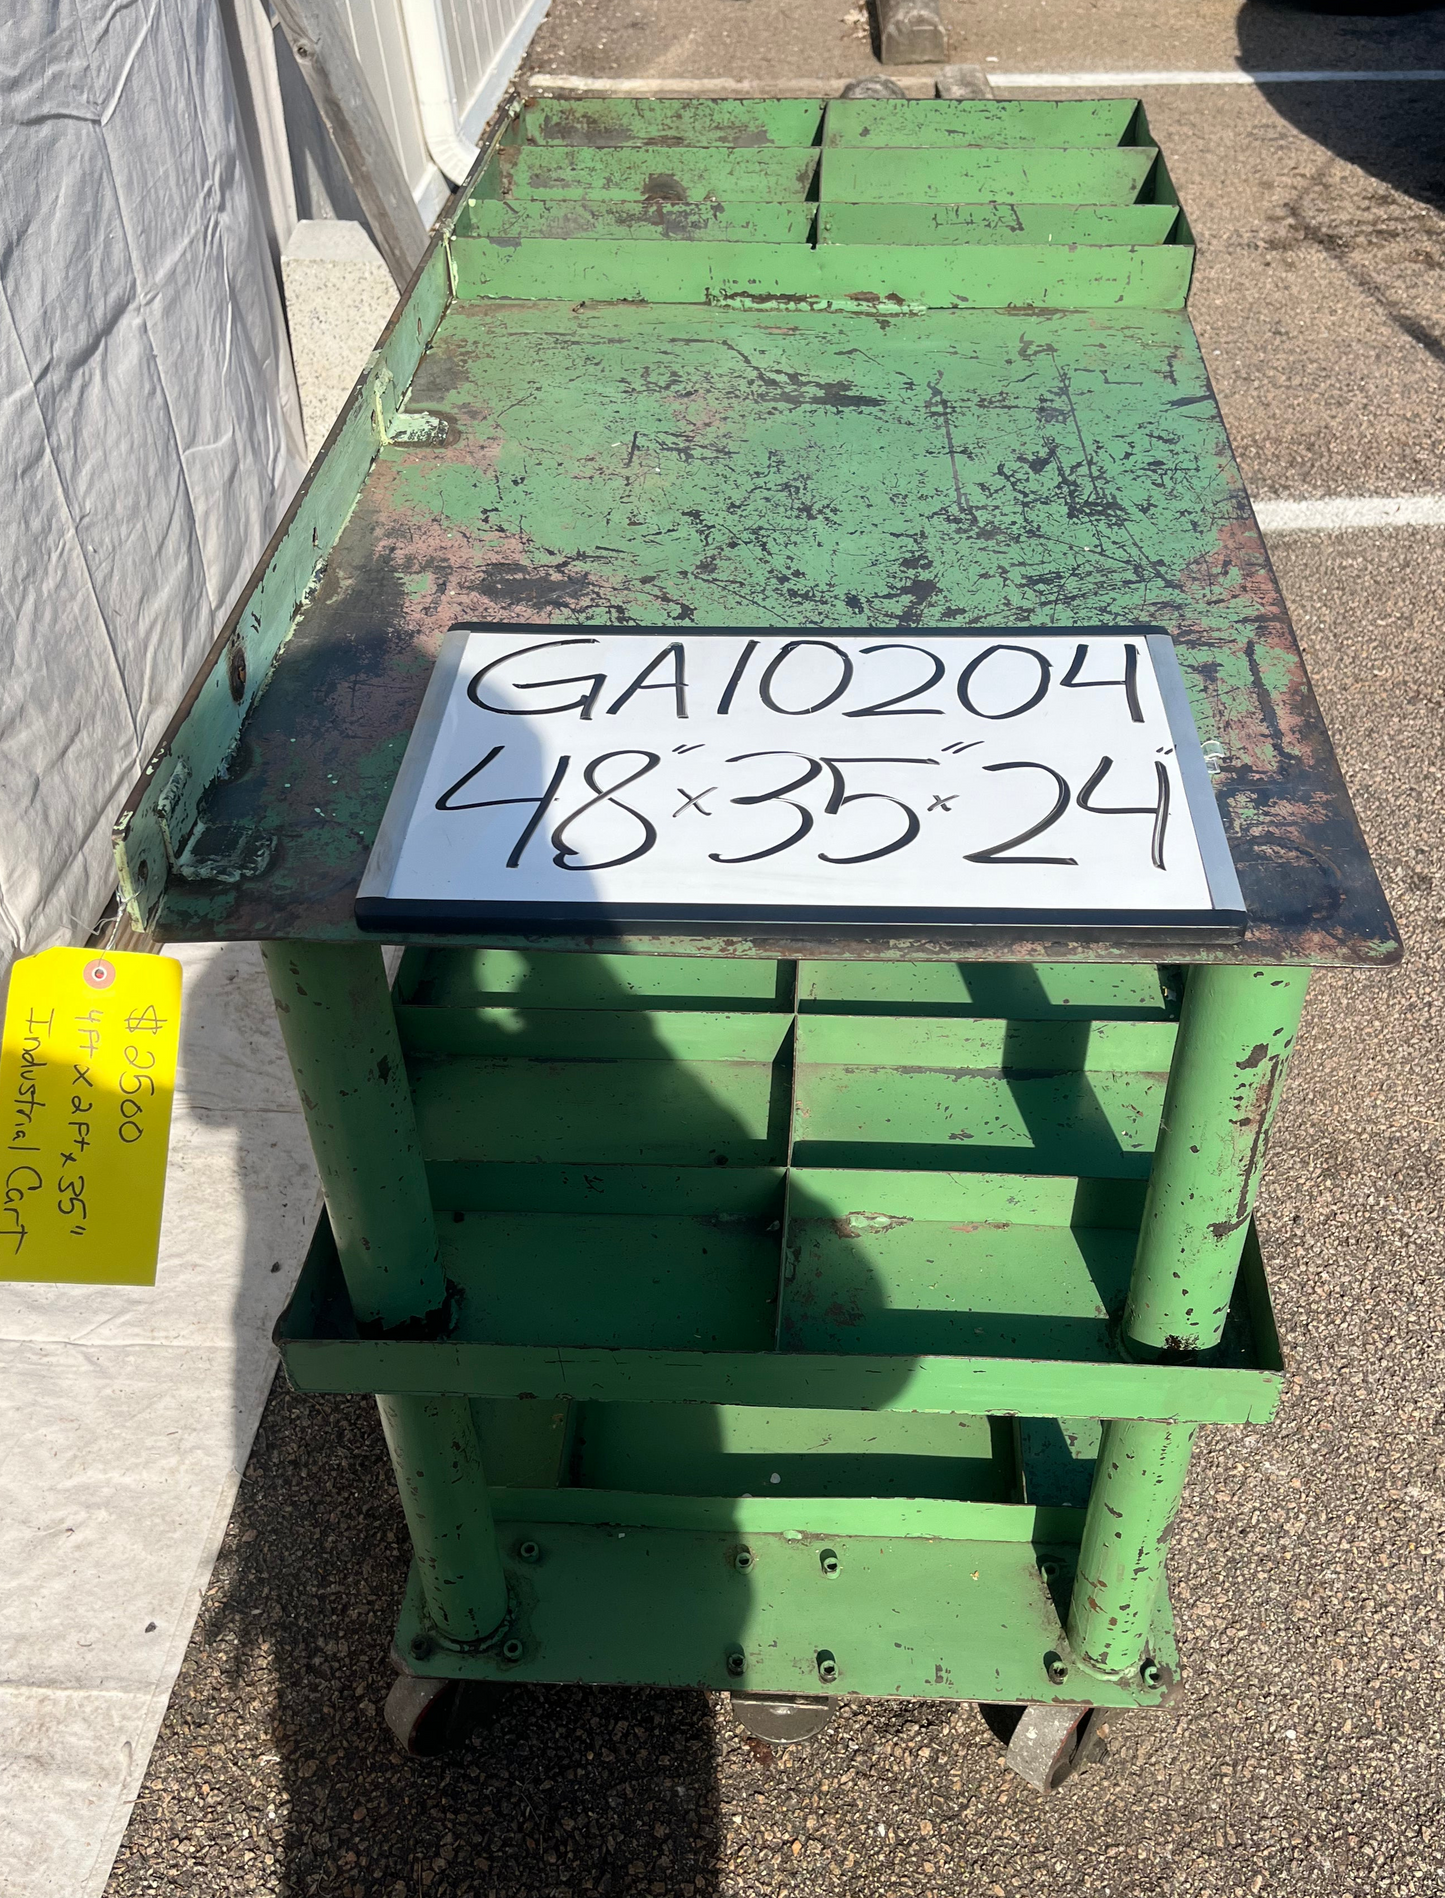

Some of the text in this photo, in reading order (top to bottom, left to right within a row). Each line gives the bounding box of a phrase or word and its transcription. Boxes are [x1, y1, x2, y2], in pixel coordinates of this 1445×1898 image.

[466, 638, 1146, 723] GA10204
[0, 1006, 55, 1256] Industrial Cart
